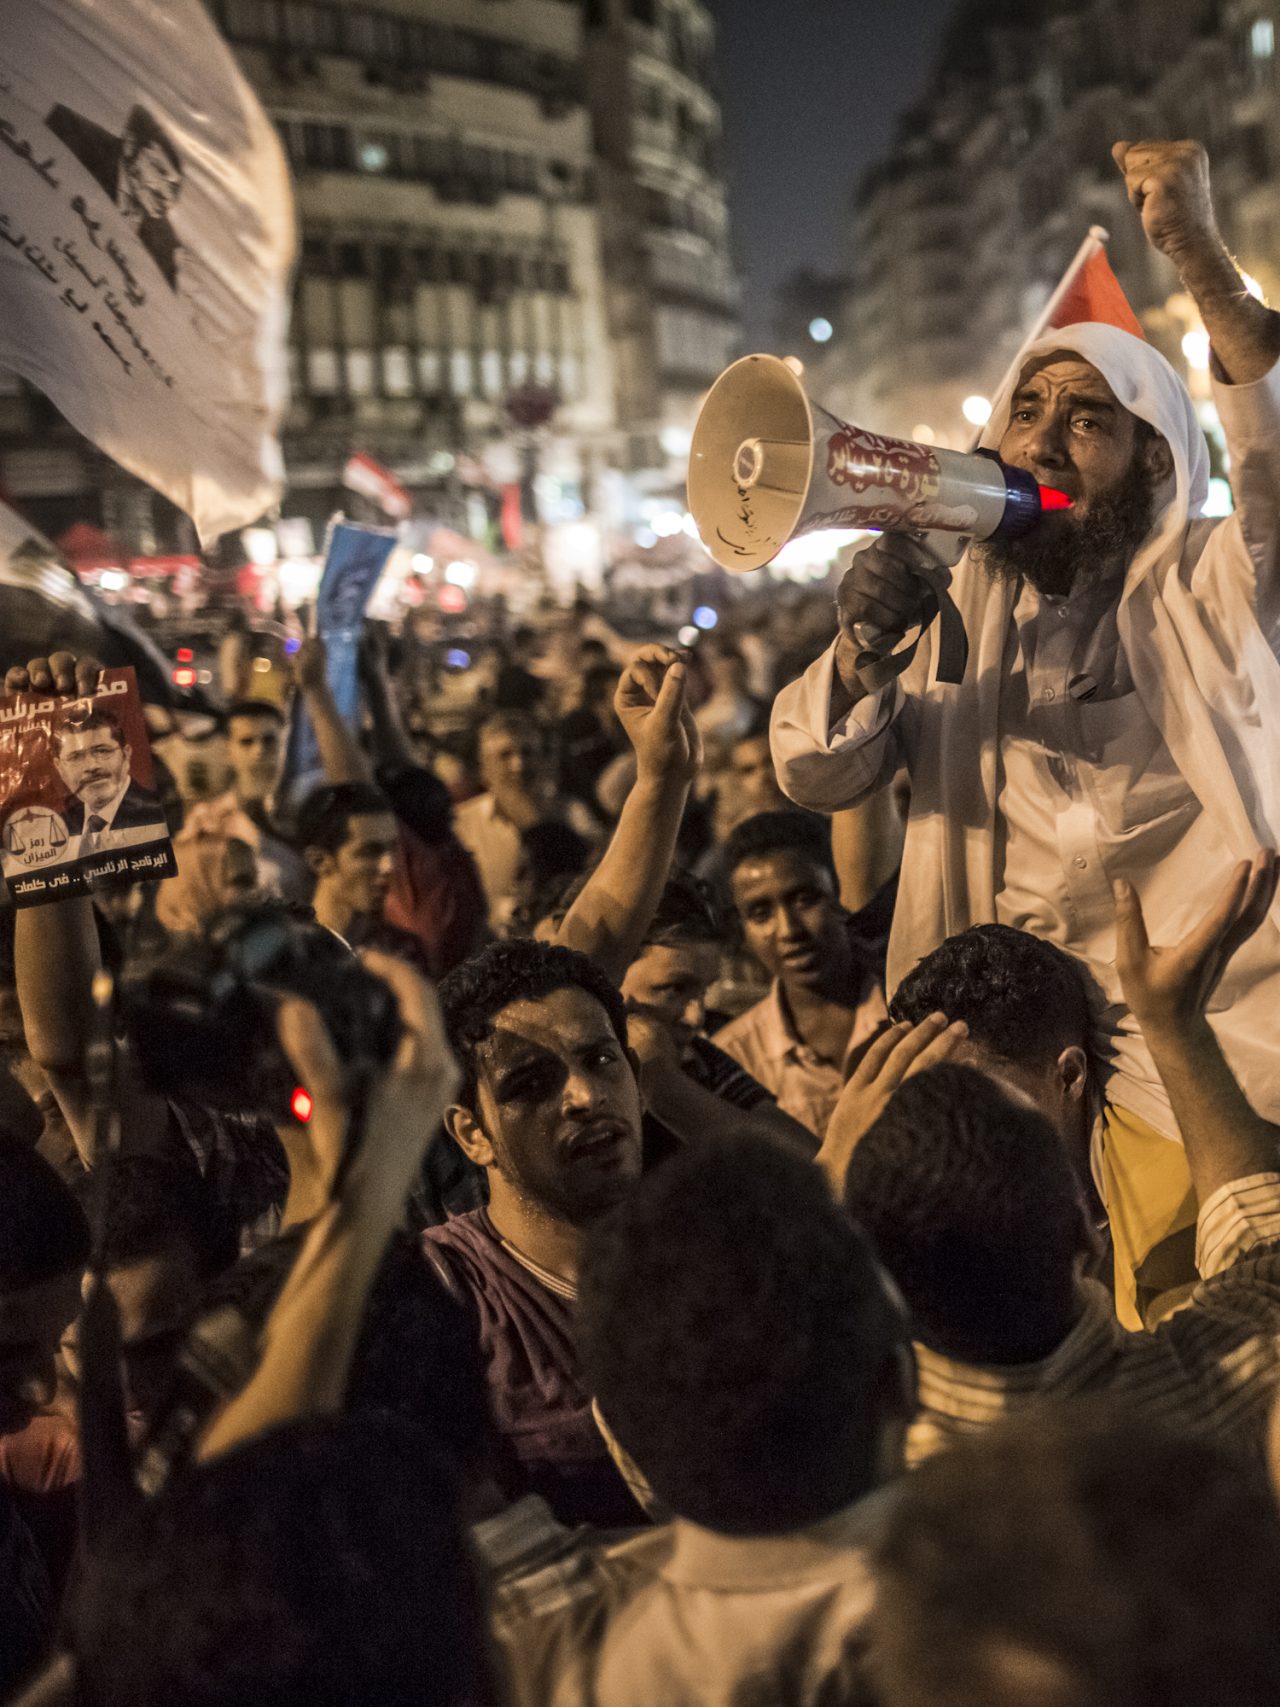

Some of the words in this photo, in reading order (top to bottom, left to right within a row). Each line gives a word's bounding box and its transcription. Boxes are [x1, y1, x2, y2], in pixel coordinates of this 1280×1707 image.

[29, 836, 46, 848] رمز
[23, 848, 57, 865] الميزان
[131, 852, 169, 871] البرنامج
[14, 878, 47, 894] كلمات
